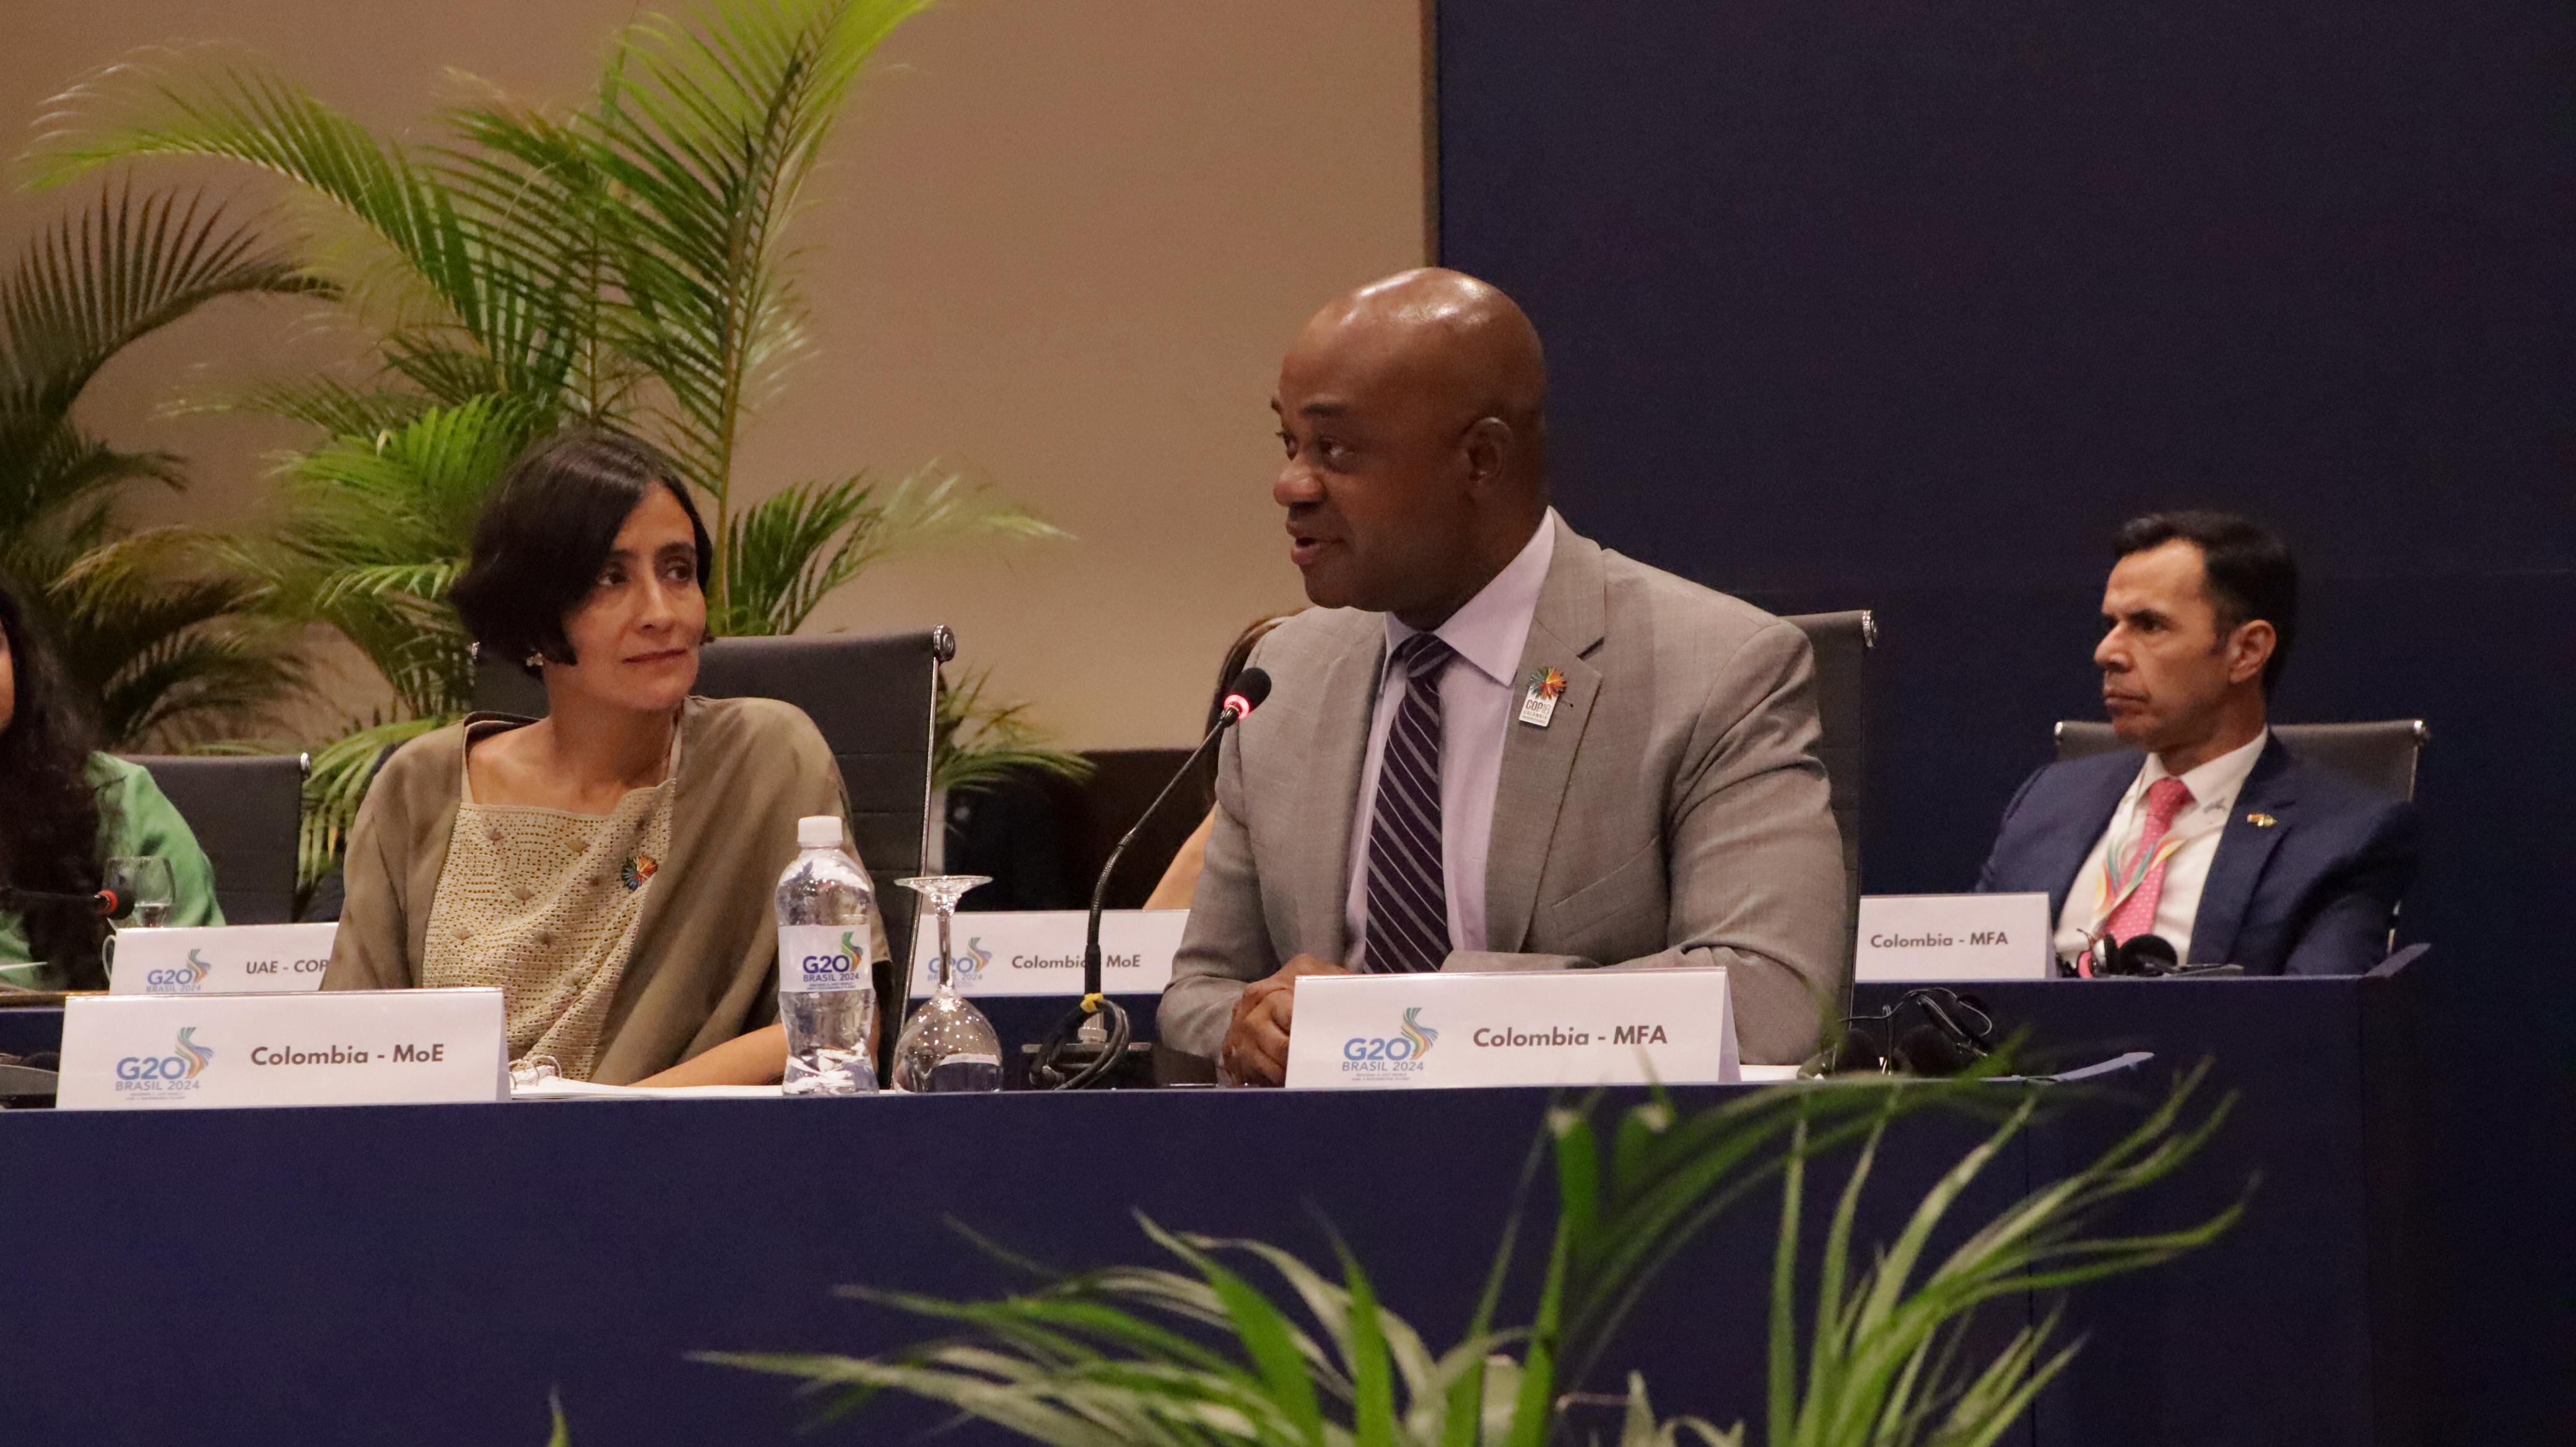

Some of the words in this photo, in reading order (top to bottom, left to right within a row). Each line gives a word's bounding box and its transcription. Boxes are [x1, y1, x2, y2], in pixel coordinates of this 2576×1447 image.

[1870, 933, 1953, 948] Colombia
[1970, 932, 2008, 945] MFA
[246, 961, 278, 974] UAE
[803, 955, 850, 974] G20
[1106, 955, 1141, 968] MoE
[147, 969, 193, 985] G20
[803, 974, 837, 982] BRASIL
[840, 973, 859, 981] 2024
[1473, 1026, 1589, 1047] Colombia
[1613, 1025, 1668, 1044] MFA
[251, 1045, 369, 1065] Colombia
[393, 1044, 444, 1062] MoE
[1344, 1038, 1411, 1061] G20
[116, 1057, 186, 1080] G20
[1342, 1062, 1388, 1072] BRASIL
[1393, 1062, 1424, 1071] 2024
[115, 1081, 163, 1091] BRASIL
[167, 1080, 200, 1090] 2024
